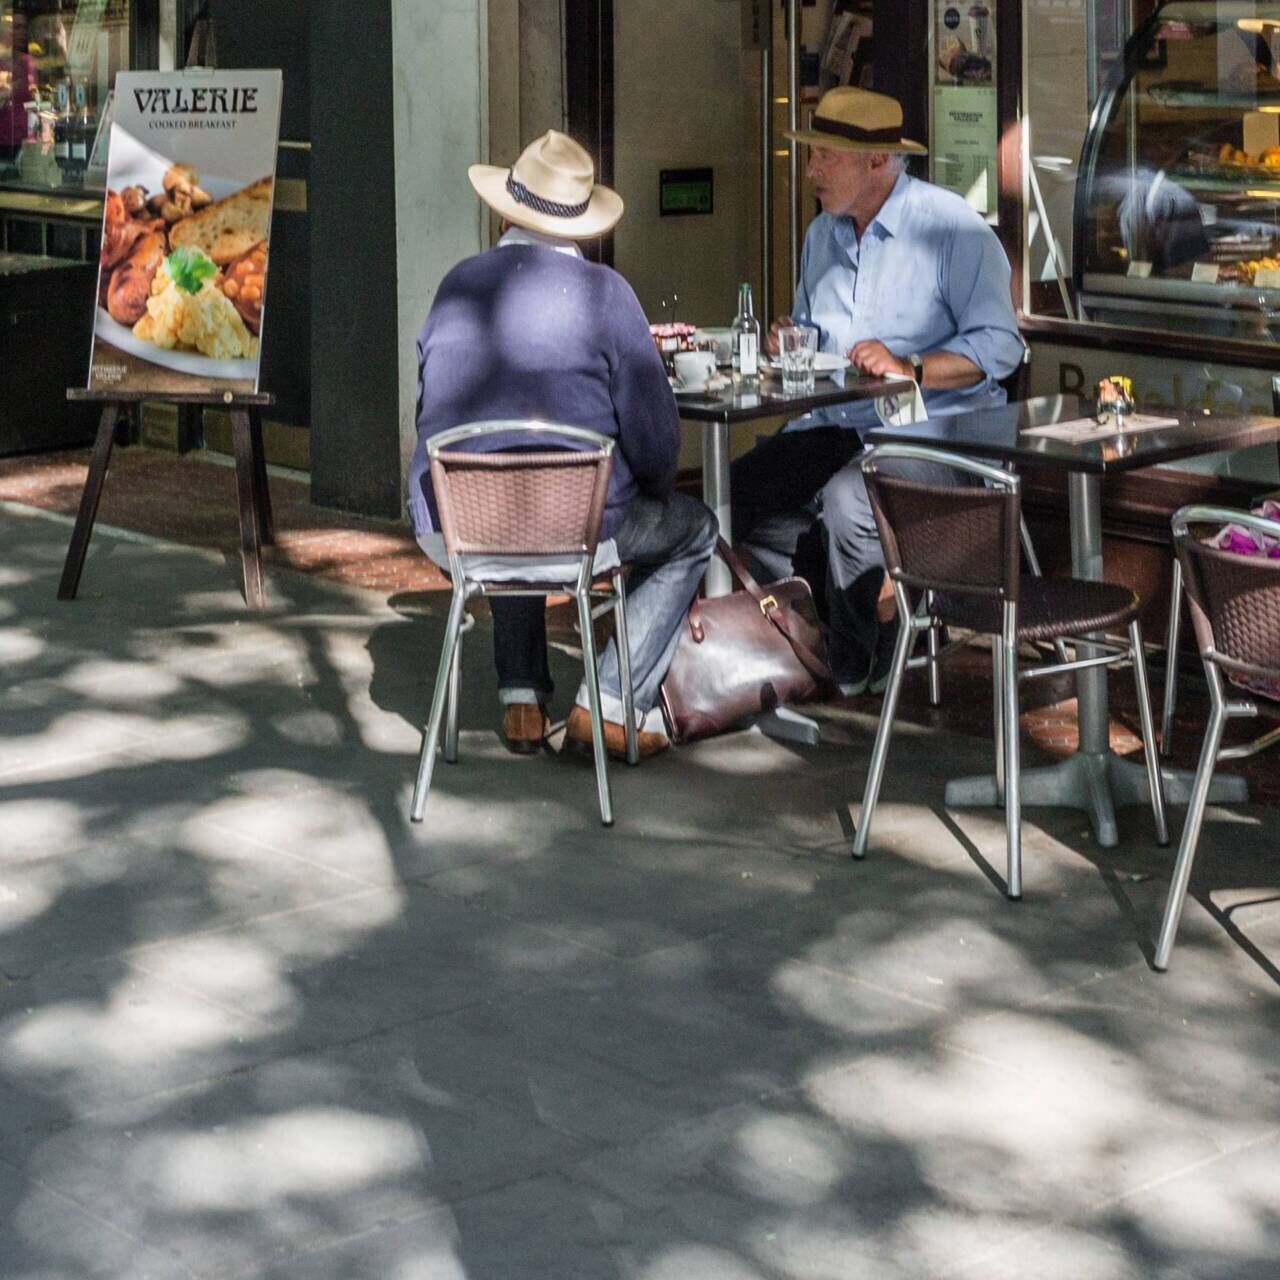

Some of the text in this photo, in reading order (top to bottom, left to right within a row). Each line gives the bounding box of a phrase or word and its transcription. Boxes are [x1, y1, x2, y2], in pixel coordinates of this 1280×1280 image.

[133, 87, 259, 114] VALERIE
[149, 119, 237, 129] COOKED BREAKFAST
